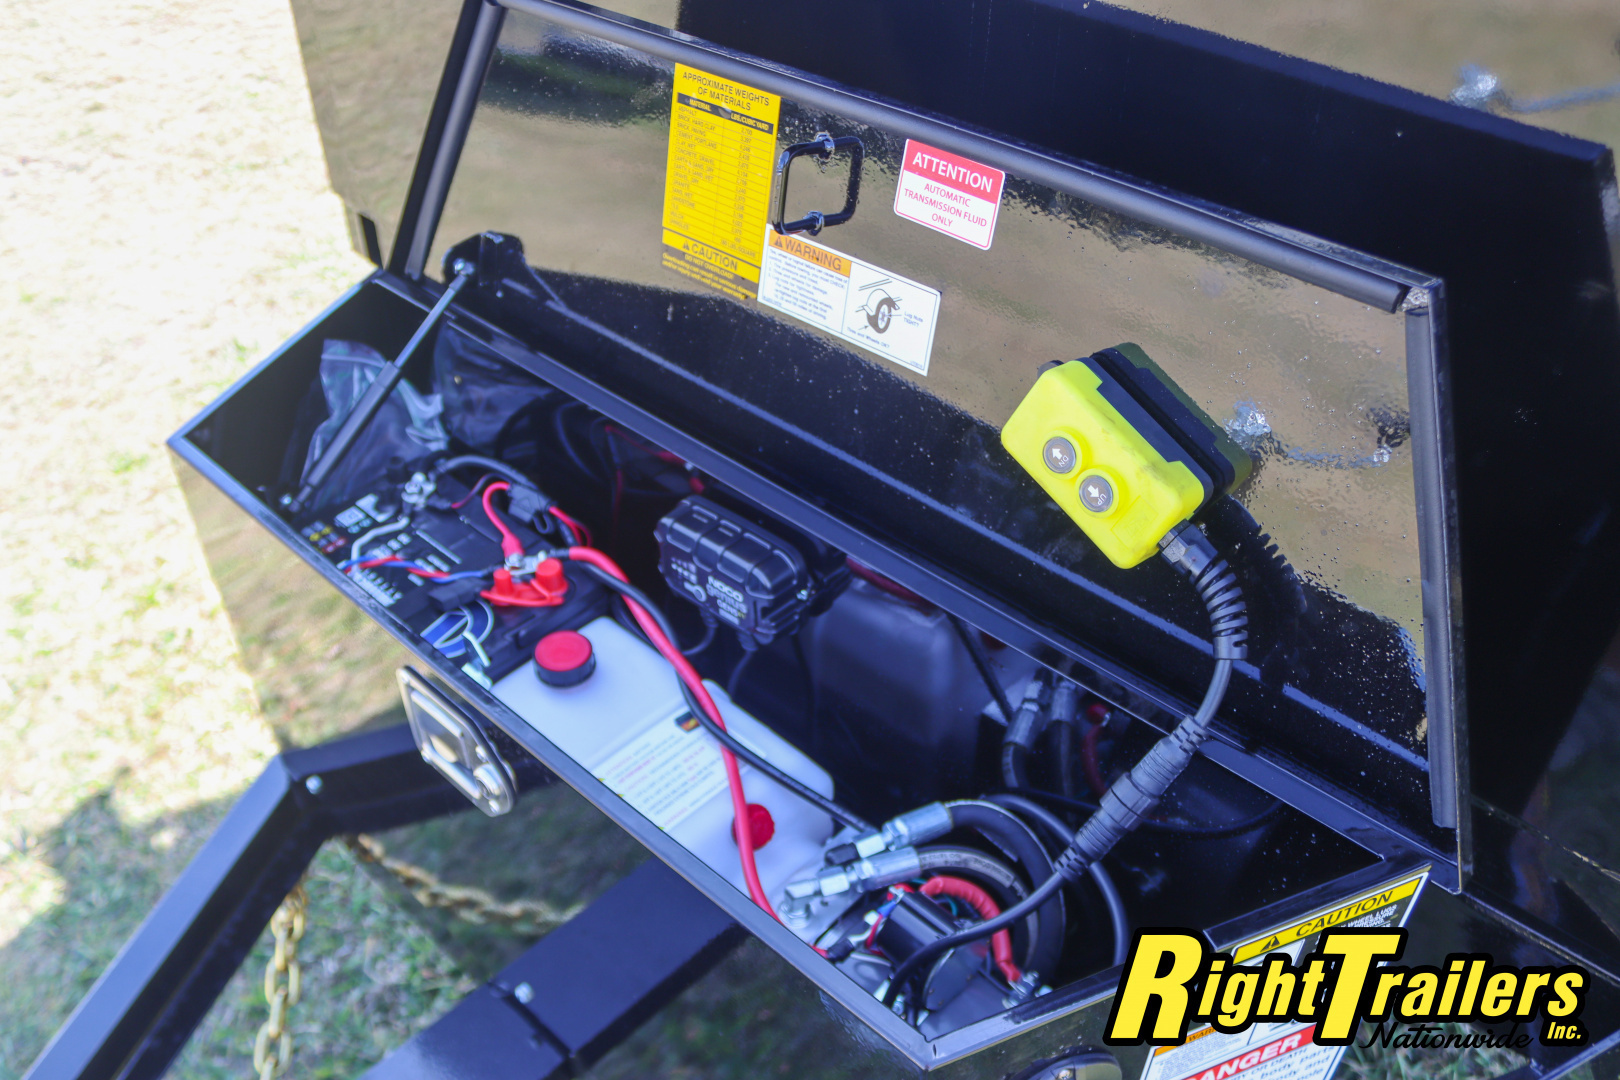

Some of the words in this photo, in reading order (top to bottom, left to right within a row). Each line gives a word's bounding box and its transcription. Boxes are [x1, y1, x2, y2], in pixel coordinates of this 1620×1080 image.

[682, 70, 733, 94] APPROXIMATE
[734, 87, 769, 106] WEIGHTS
[697, 86, 707, 96] OF
[709, 89, 751, 110] MATERIALS
[913, 152, 992, 192] ATTENTION
[905, 188, 962, 217] TRANSMISSION
[964, 212, 987, 226] FLUID
[924, 184, 970, 207] AUTOMATIC
[932, 214, 953, 227] ONLY
[691, 242, 738, 271] CAUTION
[784, 237, 841, 271] WARNING
[1059, 455, 1069, 467] DN
[1098, 494, 1106, 505] UP
[708, 575, 744, 603] NOCO
[1296, 891, 1393, 936] CAUTION
[1186, 1033, 1302, 1080] ANGER
